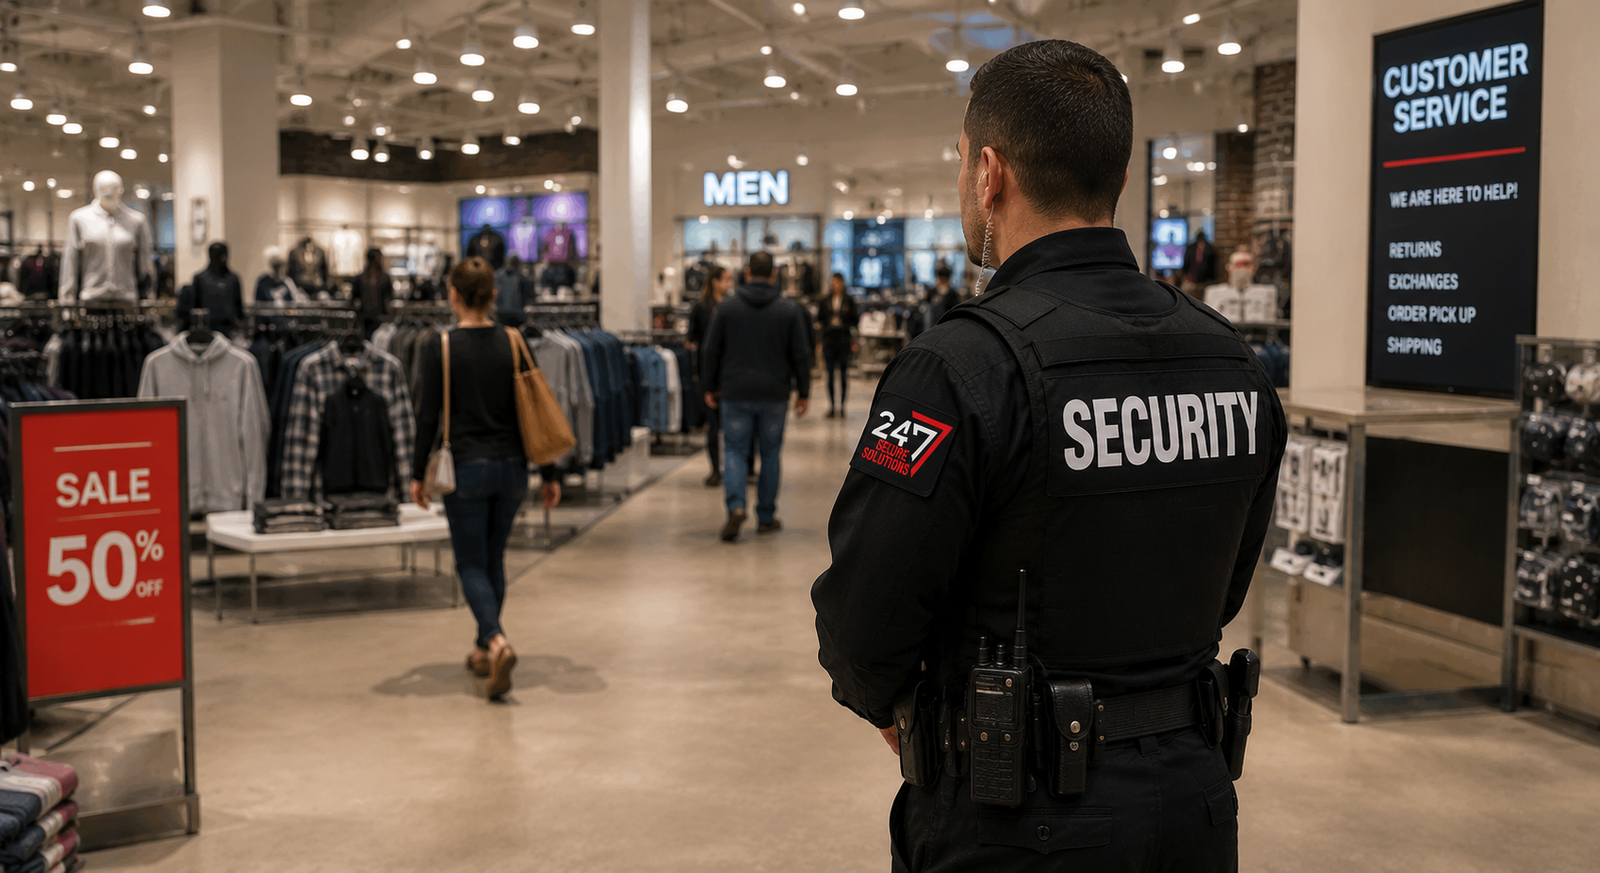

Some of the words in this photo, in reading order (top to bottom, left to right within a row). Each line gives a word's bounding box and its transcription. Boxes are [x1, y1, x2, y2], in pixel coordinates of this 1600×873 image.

[1383, 42, 1529, 98] CUSTOMER
[1393, 84, 1507, 133] SERVICE
[703, 169, 788, 206] MEN
[1389, 190, 1408, 208] WE
[1408, 188, 1432, 208] ARE
[1433, 186, 1464, 205] HERE
[1465, 185, 1482, 202] TO
[1483, 182, 1518, 201] HELP!
[1389, 240, 1442, 259] RETURNS
[1388, 272, 1459, 290] EXCHANGES
[1387, 304, 1427, 322] ORDER
[1428, 305, 1457, 323] PICK
[1458, 306, 1477, 324] UP
[1386, 336, 1442, 356] SHIPPING
[871, 410, 938, 462] 247
[1062, 391, 1258, 471] SECURITY
[861, 446, 910, 476] SOLUTIONS
[875, 439, 910, 462] SECURE
[55, 467, 151, 508] SALE
[135, 578, 163, 598] OFF
